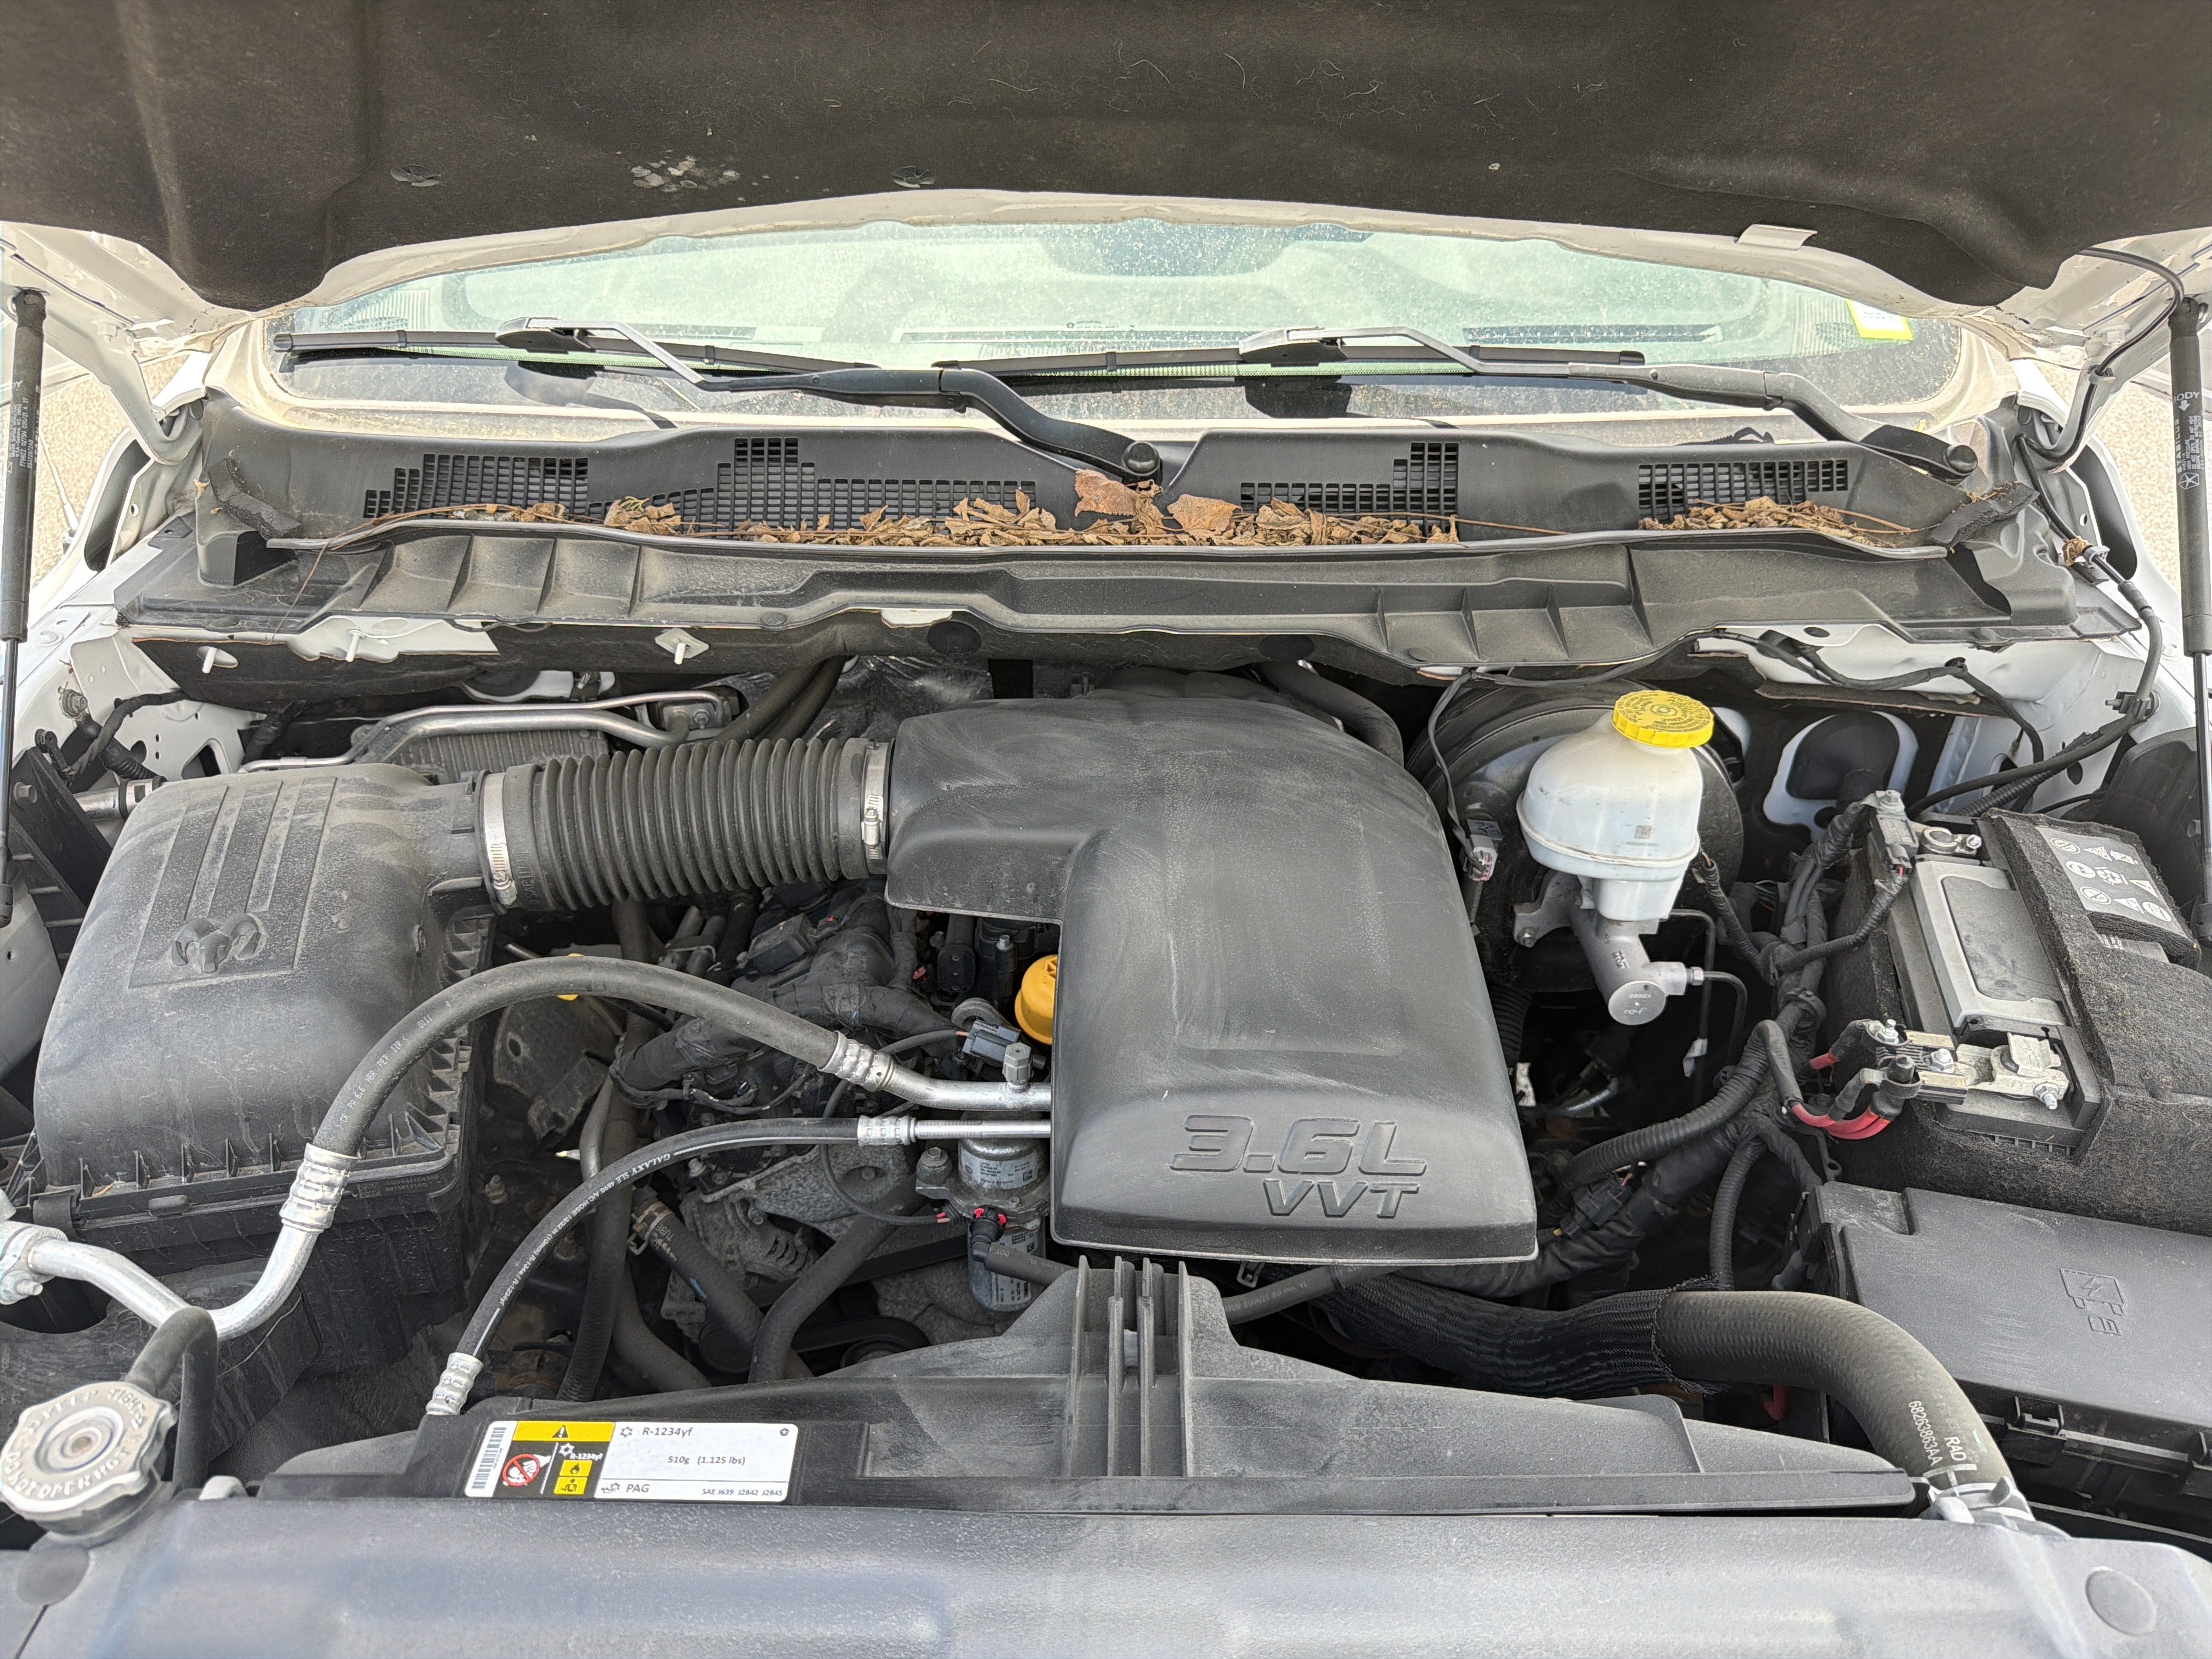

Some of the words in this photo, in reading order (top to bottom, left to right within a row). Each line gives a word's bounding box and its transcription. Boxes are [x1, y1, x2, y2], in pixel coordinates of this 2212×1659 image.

[347, 1099, 358, 1109] PA
[354, 1085, 366, 1099] 6.6
[1169, 1114, 1426, 1176] 3.6L
[631, 1153, 671, 1176] GALAXY
[615, 1171, 630, 1183] SLE
[588, 1190, 600, 1202] A/C
[599, 1181, 615, 1194] 4890
[1263, 1178, 1420, 1219] VVT
[571, 1199, 590, 1217] HOSE
[556, 1214, 573, 1230] 13/32
[656, 1223, 675, 1241] TUBE
[533, 1233, 554, 1256] (10mm)
[996, 1248, 1010, 1257] DOT
[518, 1254, 537, 1276] R-134a
[499, 1278, 520, 1306] R-1234yf
[642, 1426, 694, 1437] R-1234yf
[1908, 1400, 1944, 1466] 68263863AA
[570, 1452, 604, 1460] R-1234yf
[1944, 1436, 1967, 1462] RAD
[667, 1455, 690, 1465] 510g
[697, 1455, 726, 1465] (1.125
[728, 1455, 746, 1466] lbs)
[626, 1483, 650, 1493] PAG
